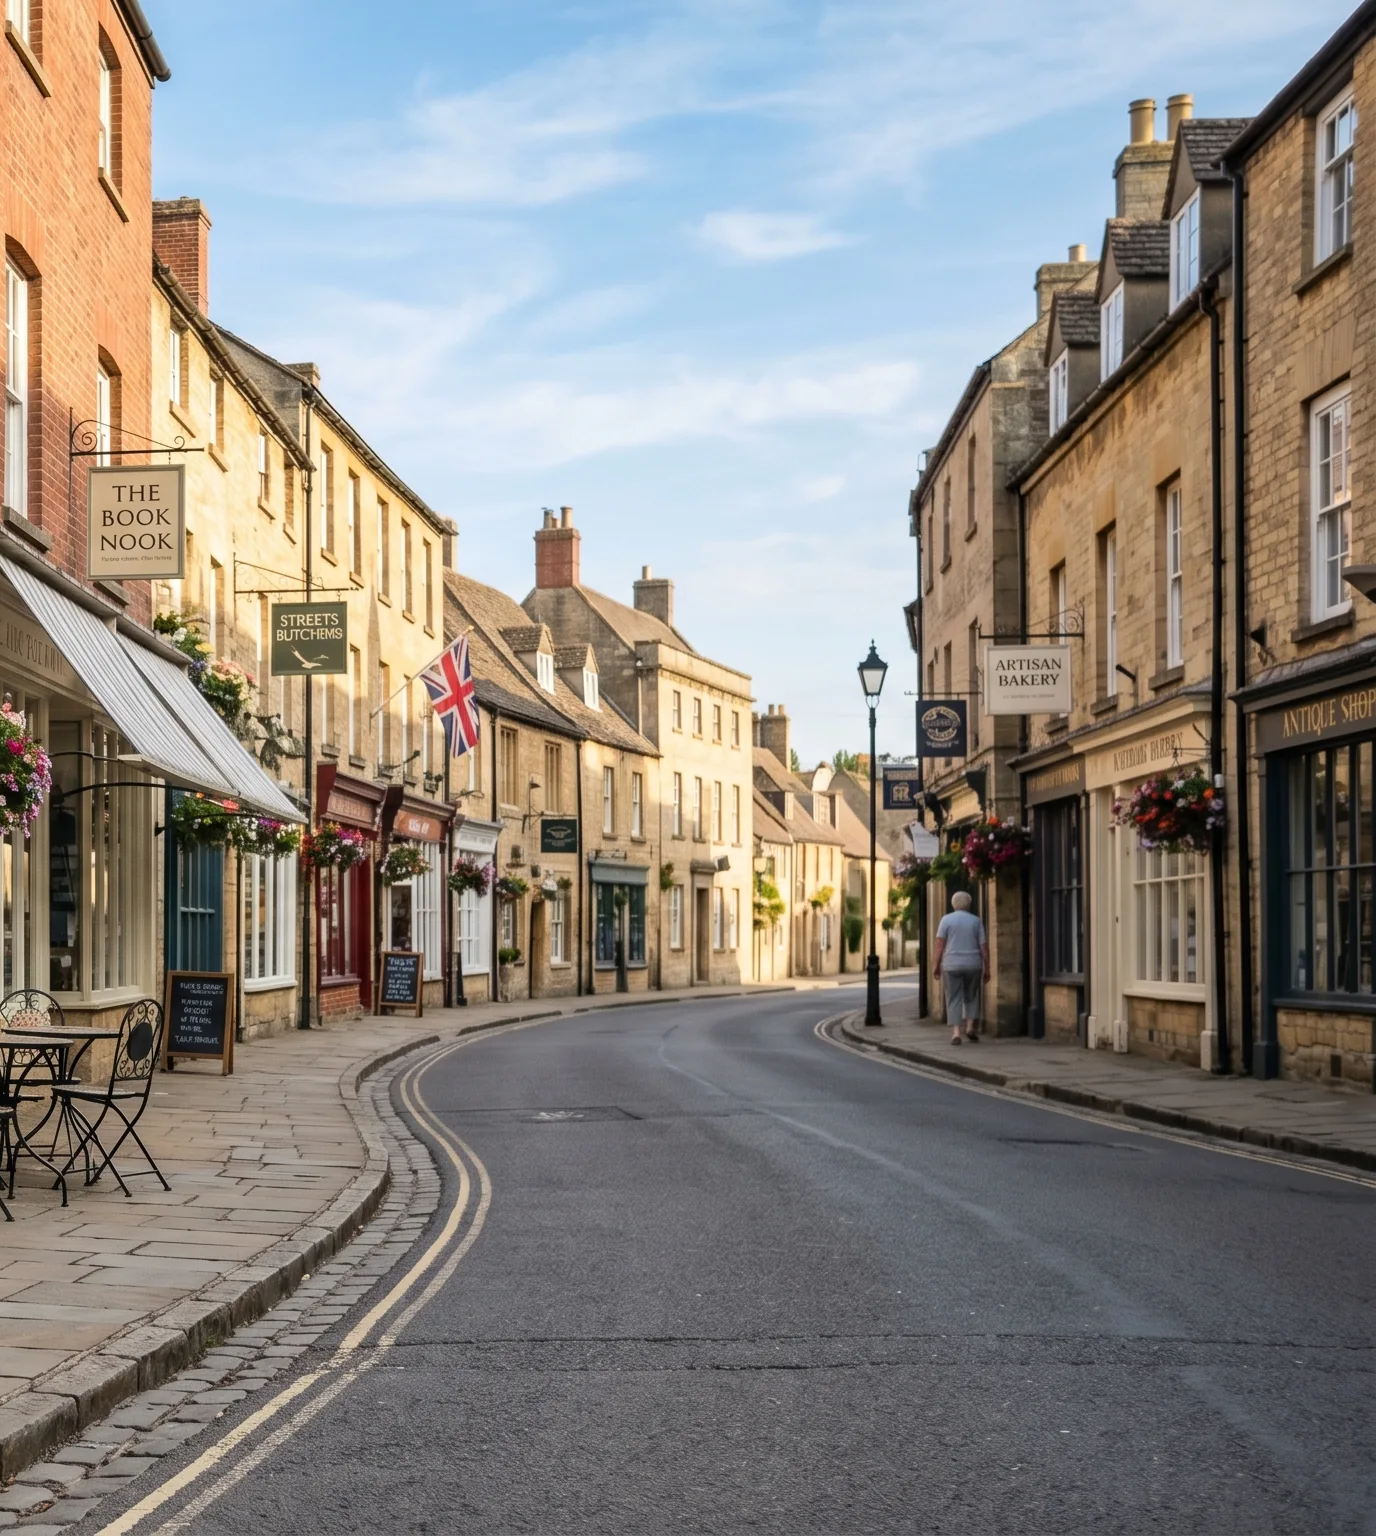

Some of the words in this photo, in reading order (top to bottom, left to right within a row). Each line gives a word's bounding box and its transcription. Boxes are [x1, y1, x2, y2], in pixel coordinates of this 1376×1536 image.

[111, 484, 160, 503] THE
[102, 508, 171, 527] BOOK
[100, 532, 174, 551] NOOK
[280, 613, 339, 628] STREETS
[995, 657, 1062, 671] ARTISAN
[998, 673, 1060, 687] BAKERY
[1283, 699, 1337, 738] ANTIQUE
